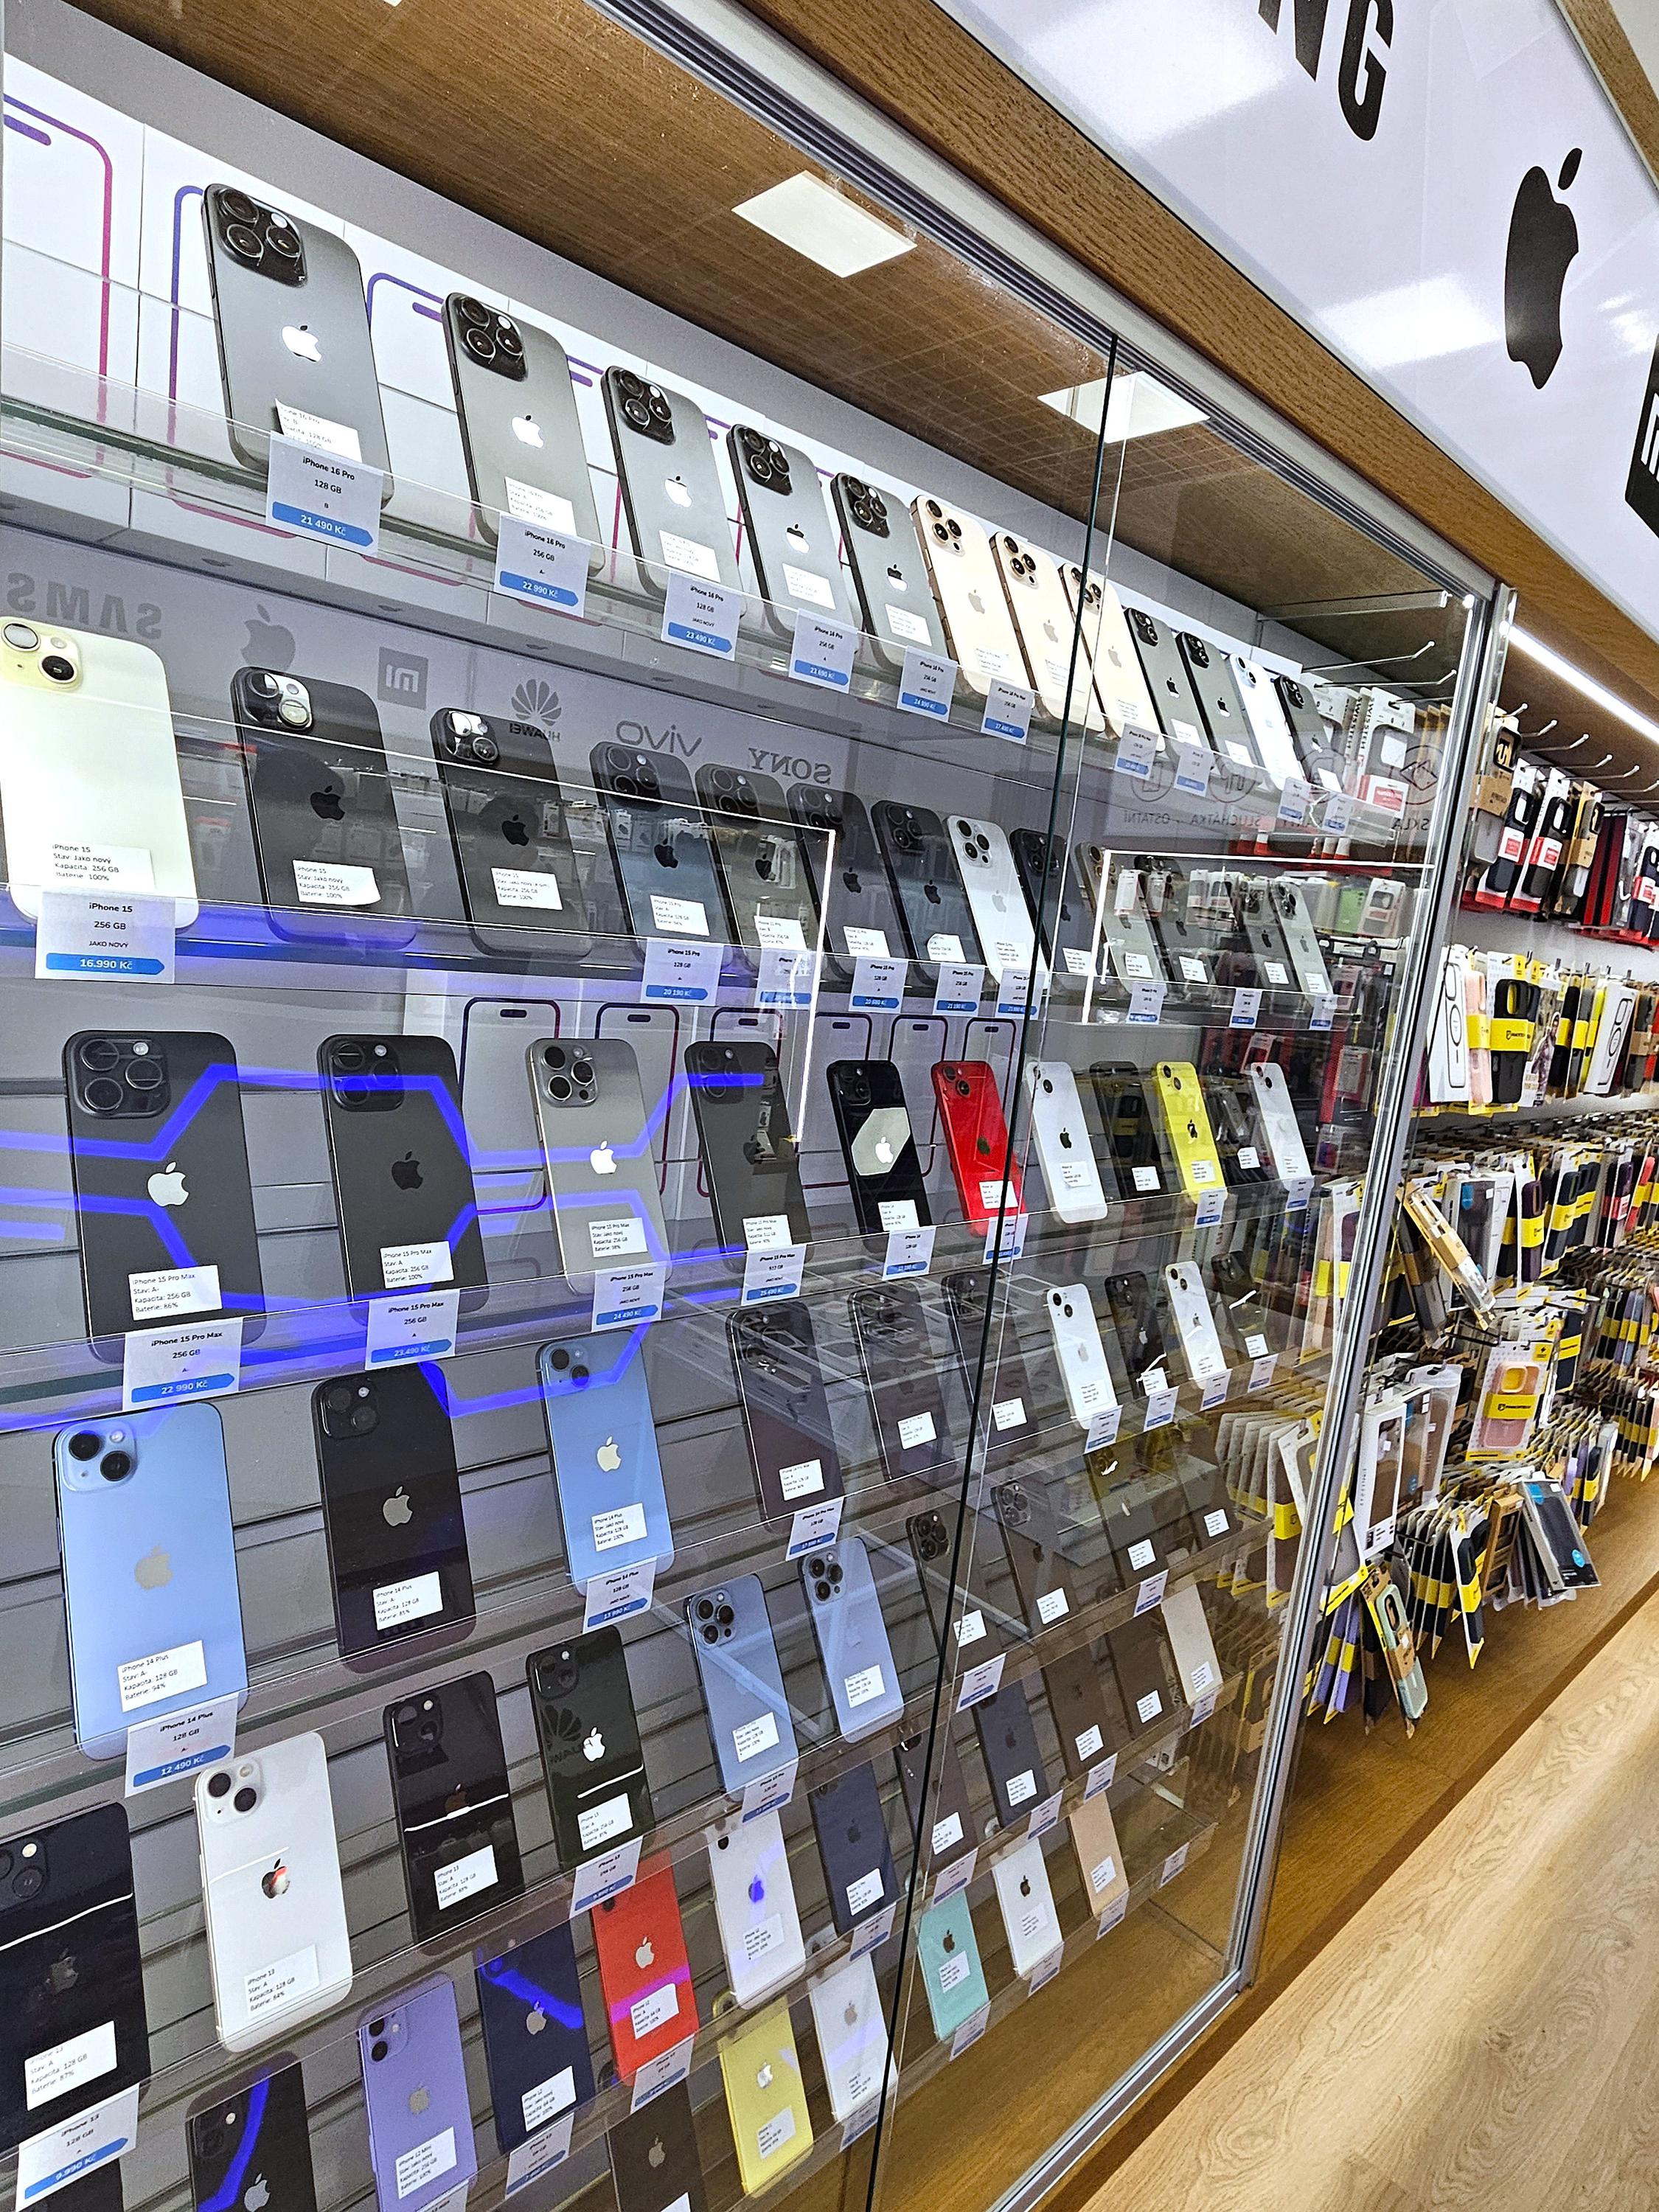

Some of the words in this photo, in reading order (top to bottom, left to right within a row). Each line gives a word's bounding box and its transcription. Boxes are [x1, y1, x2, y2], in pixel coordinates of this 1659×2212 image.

[302, 456, 329, 471] iPhone
[331, 467, 340, 476] 16
[341, 469, 355, 480] Pro
[314, 479, 329, 490] 128
[330, 484, 342, 494] GB
[301, 515, 313, 525] 21
[315, 518, 333, 531] 490
[334, 525, 346, 536] Kč
[524, 530, 545, 542] iPhone
[555, 540, 566, 549] Pro
[533, 549, 544, 558] 256
[546, 552, 555, 561] GB
[523, 581, 532, 590] 22
[534, 584, 547, 595] 990
[690, 585, 707, 597] iPhone
[52, 844, 79, 853] iPhone
[92, 864, 106, 872] 256
[88, 902, 119, 911] iPhone
[121, 905, 133, 913] 15
[94, 921, 111, 929] 256
[113, 922, 126, 931] GB
[80, 959, 116, 969] 16.990
[119, 960, 133, 970] Kč
[151, 1338, 178, 1347] iPhone
[172, 1351, 188, 1359] 256
[175, 1382, 193, 1392] 990
[122, 1661, 145, 1673] iPhone
[155, 1655, 169, 1663] Plus
[156, 1673, 167, 1682] 128
[160, 1720, 185, 1732] iPhone
[198, 1711, 213, 1720] Plus
[173, 1733, 187, 1742] 128
[188, 1728, 200, 1736] GB
[161, 1767, 173, 1775] 12
[174, 1760, 192, 1770] 490
[77, 2053, 88, 2062] GB
[61, 2121, 87, 2136] iPhone
[91, 2114, 100, 2123] 13
[66, 2136, 80, 2146] 128
[82, 2129, 94, 2138] GB
